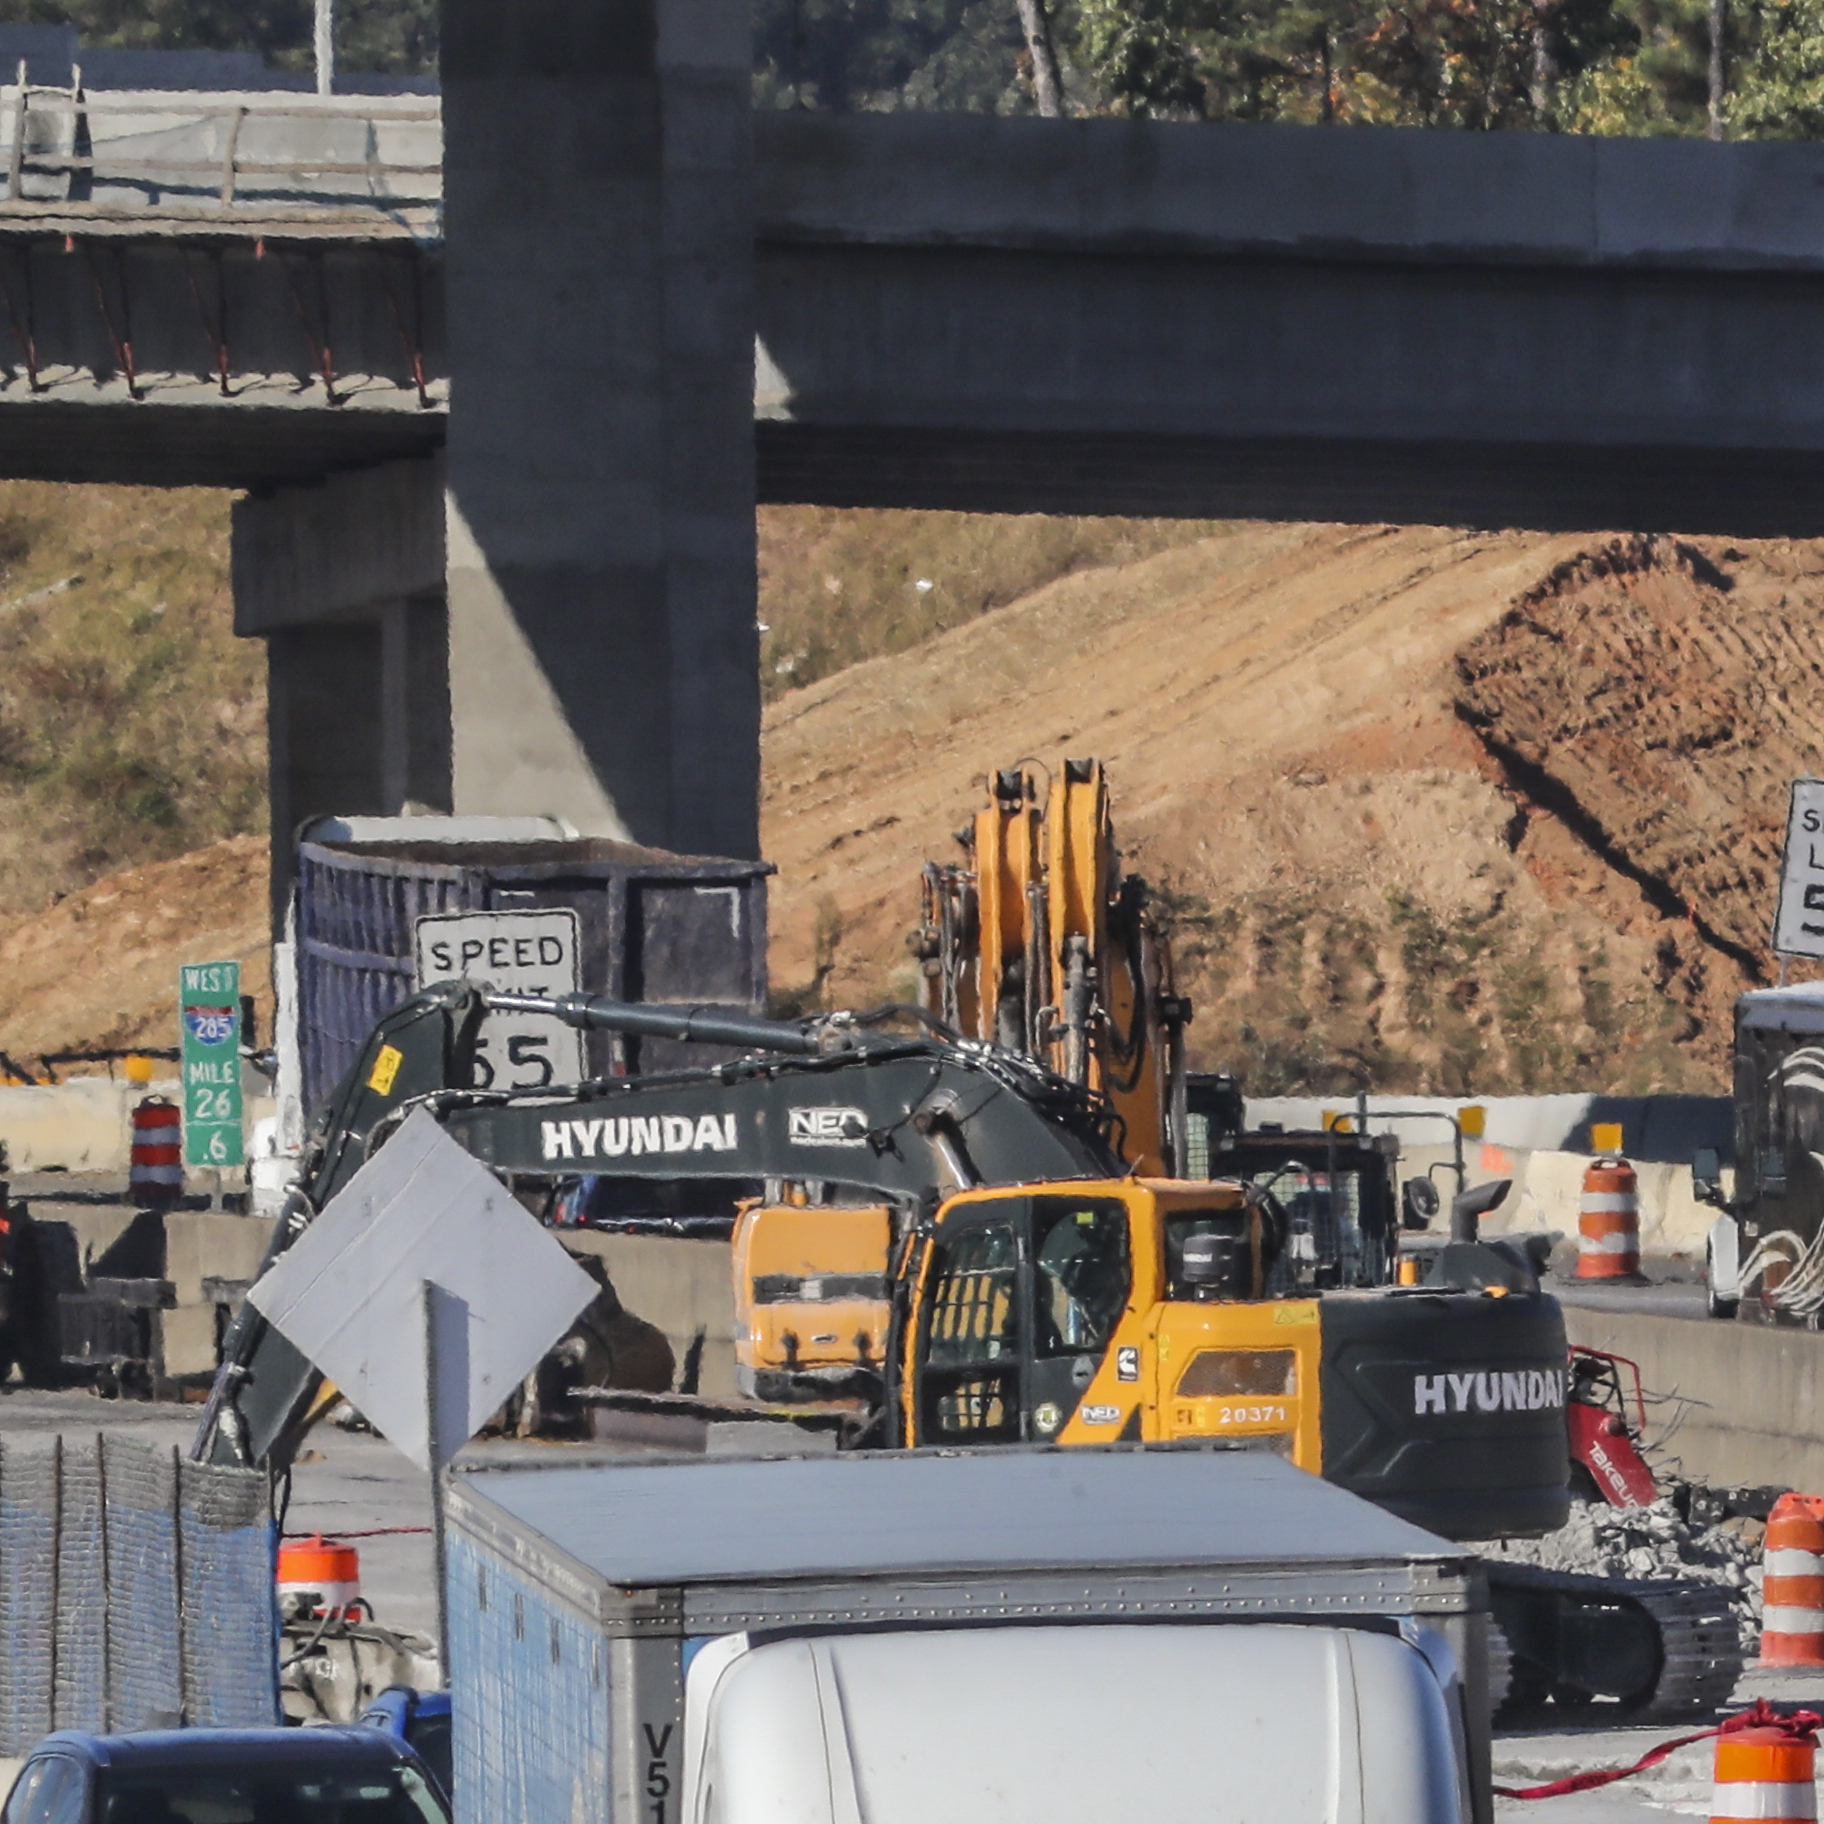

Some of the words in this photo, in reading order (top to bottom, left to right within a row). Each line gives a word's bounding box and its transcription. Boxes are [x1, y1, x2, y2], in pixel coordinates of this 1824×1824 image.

[431, 936, 563, 971] SPEED
[184, 966, 234, 992] WEST
[196, 1016, 231, 1039] 285
[189, 1061, 235, 1085] MILE
[195, 1088, 231, 1119] 26
[203, 1131, 228, 1161] .6
[541, 1112, 738, 1160] HYUNDAI
[1414, 1369, 1564, 1414] HYUNDAI
[1219, 1407, 1286, 1424] 20371
